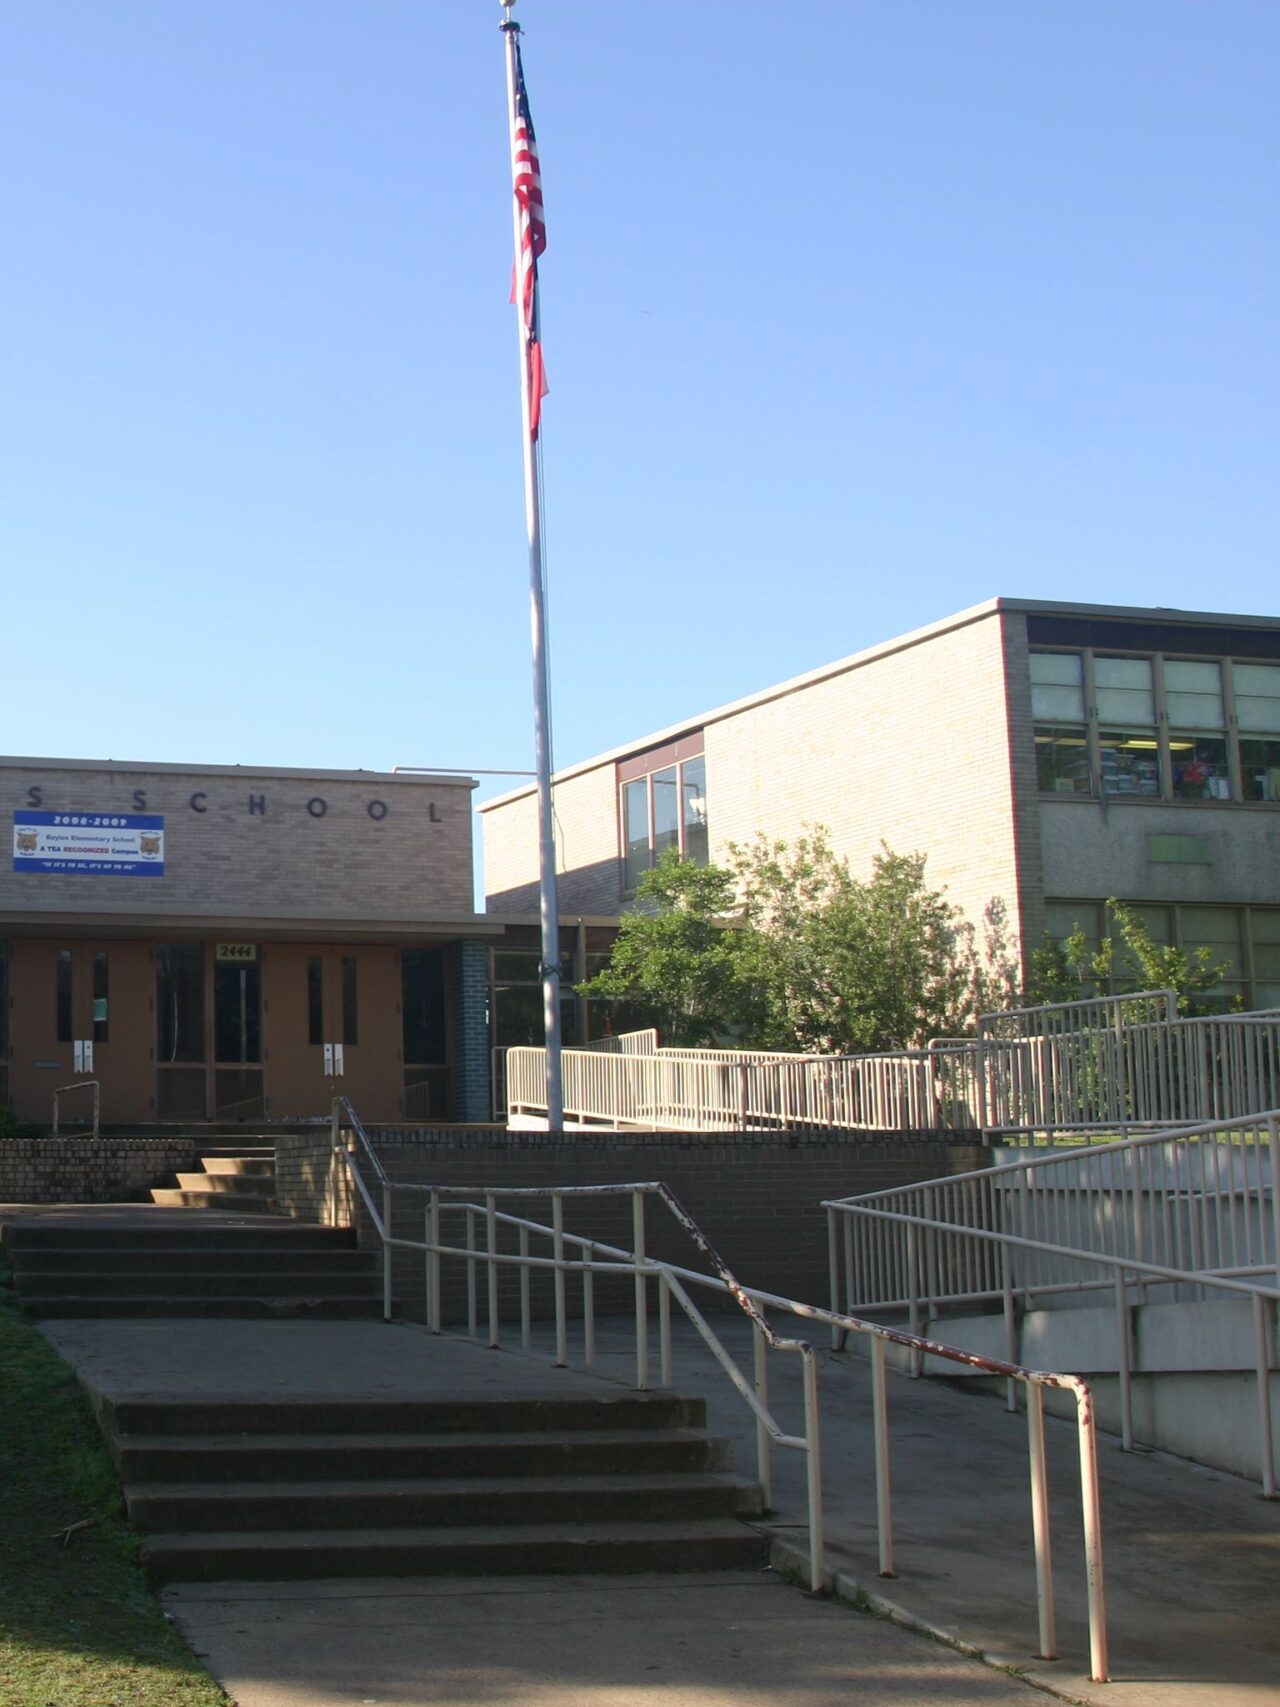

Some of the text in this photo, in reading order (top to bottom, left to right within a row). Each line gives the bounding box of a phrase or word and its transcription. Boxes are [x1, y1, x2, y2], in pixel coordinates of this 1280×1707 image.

[132, 789, 443, 823] SCHOOL
[53, 815, 128, 827] 2008-2009
[71, 834, 110, 844] Elementary
[112, 836, 136, 844] School
[63, 846, 110, 854] RECOGNIZED
[111, 847, 139, 856] Campus
[220, 945, 252, 957] 2444
